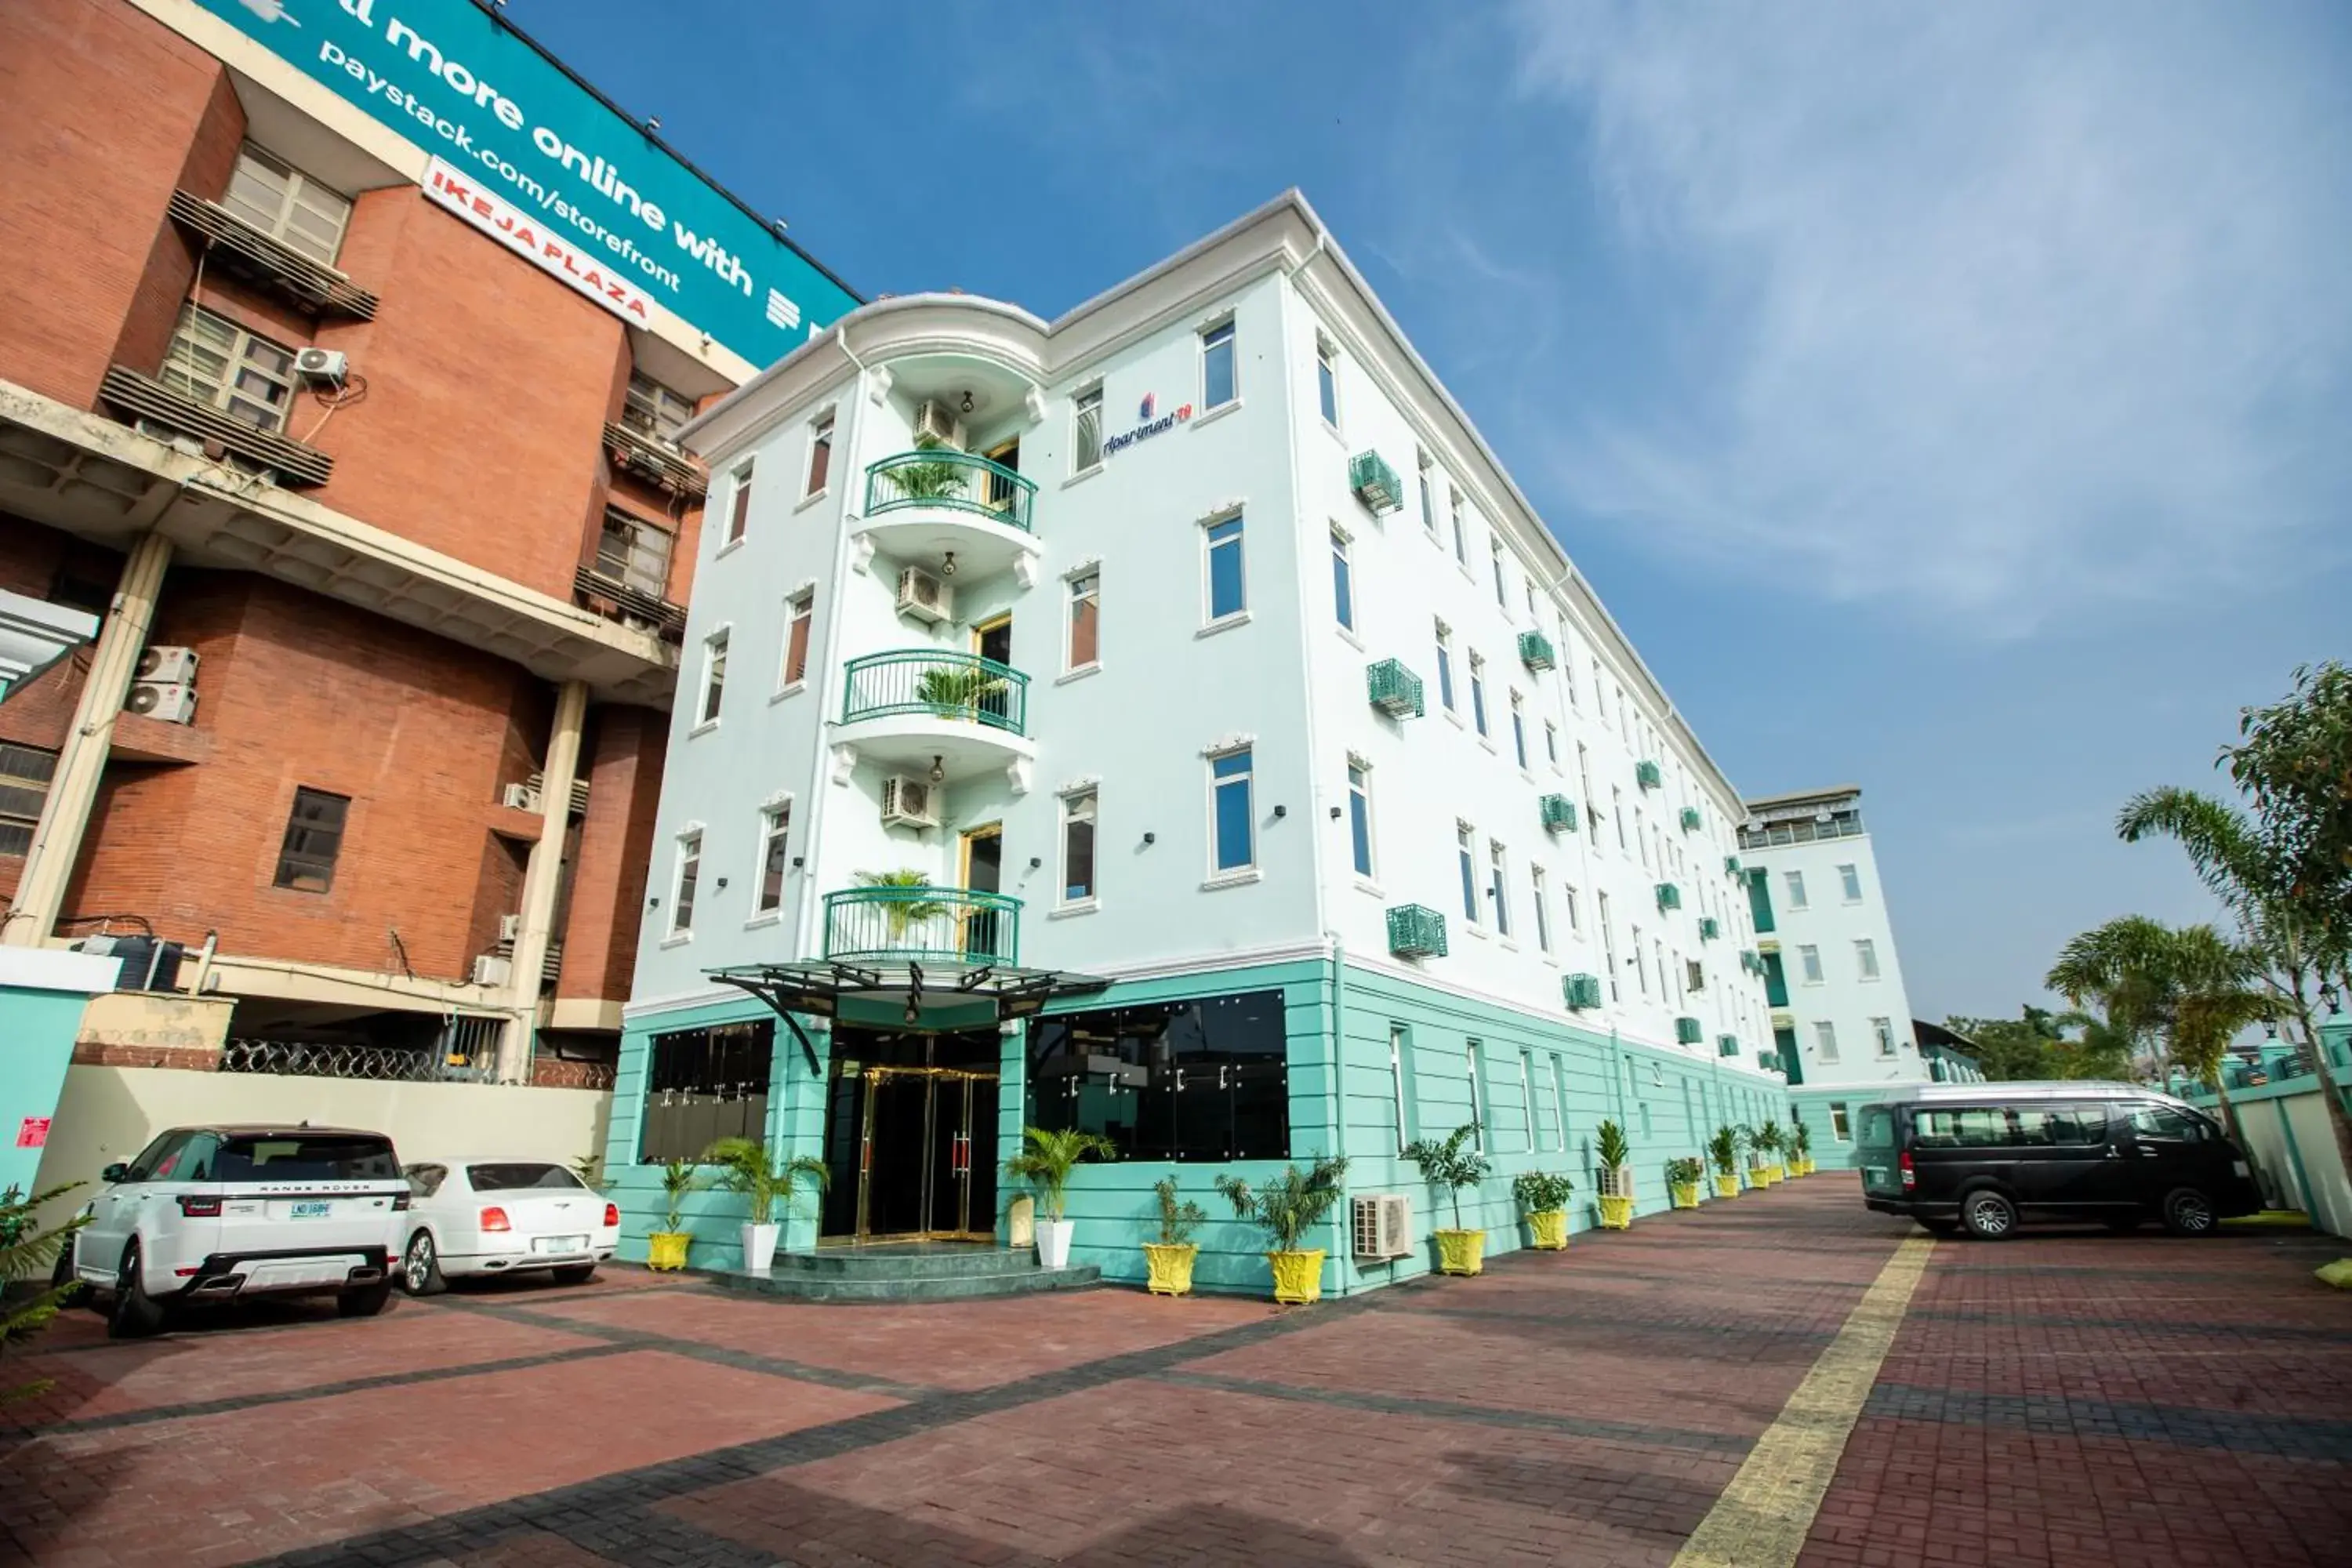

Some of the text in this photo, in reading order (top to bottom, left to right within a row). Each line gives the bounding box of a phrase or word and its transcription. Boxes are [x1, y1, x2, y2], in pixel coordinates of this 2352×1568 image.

[319, 40, 681, 293] paystack.com/storefront
[387, 17, 524, 130] more
[532, 126, 666, 231] online
[673, 221, 753, 296] with
[433, 171, 646, 318] IKEJA PLAZA
